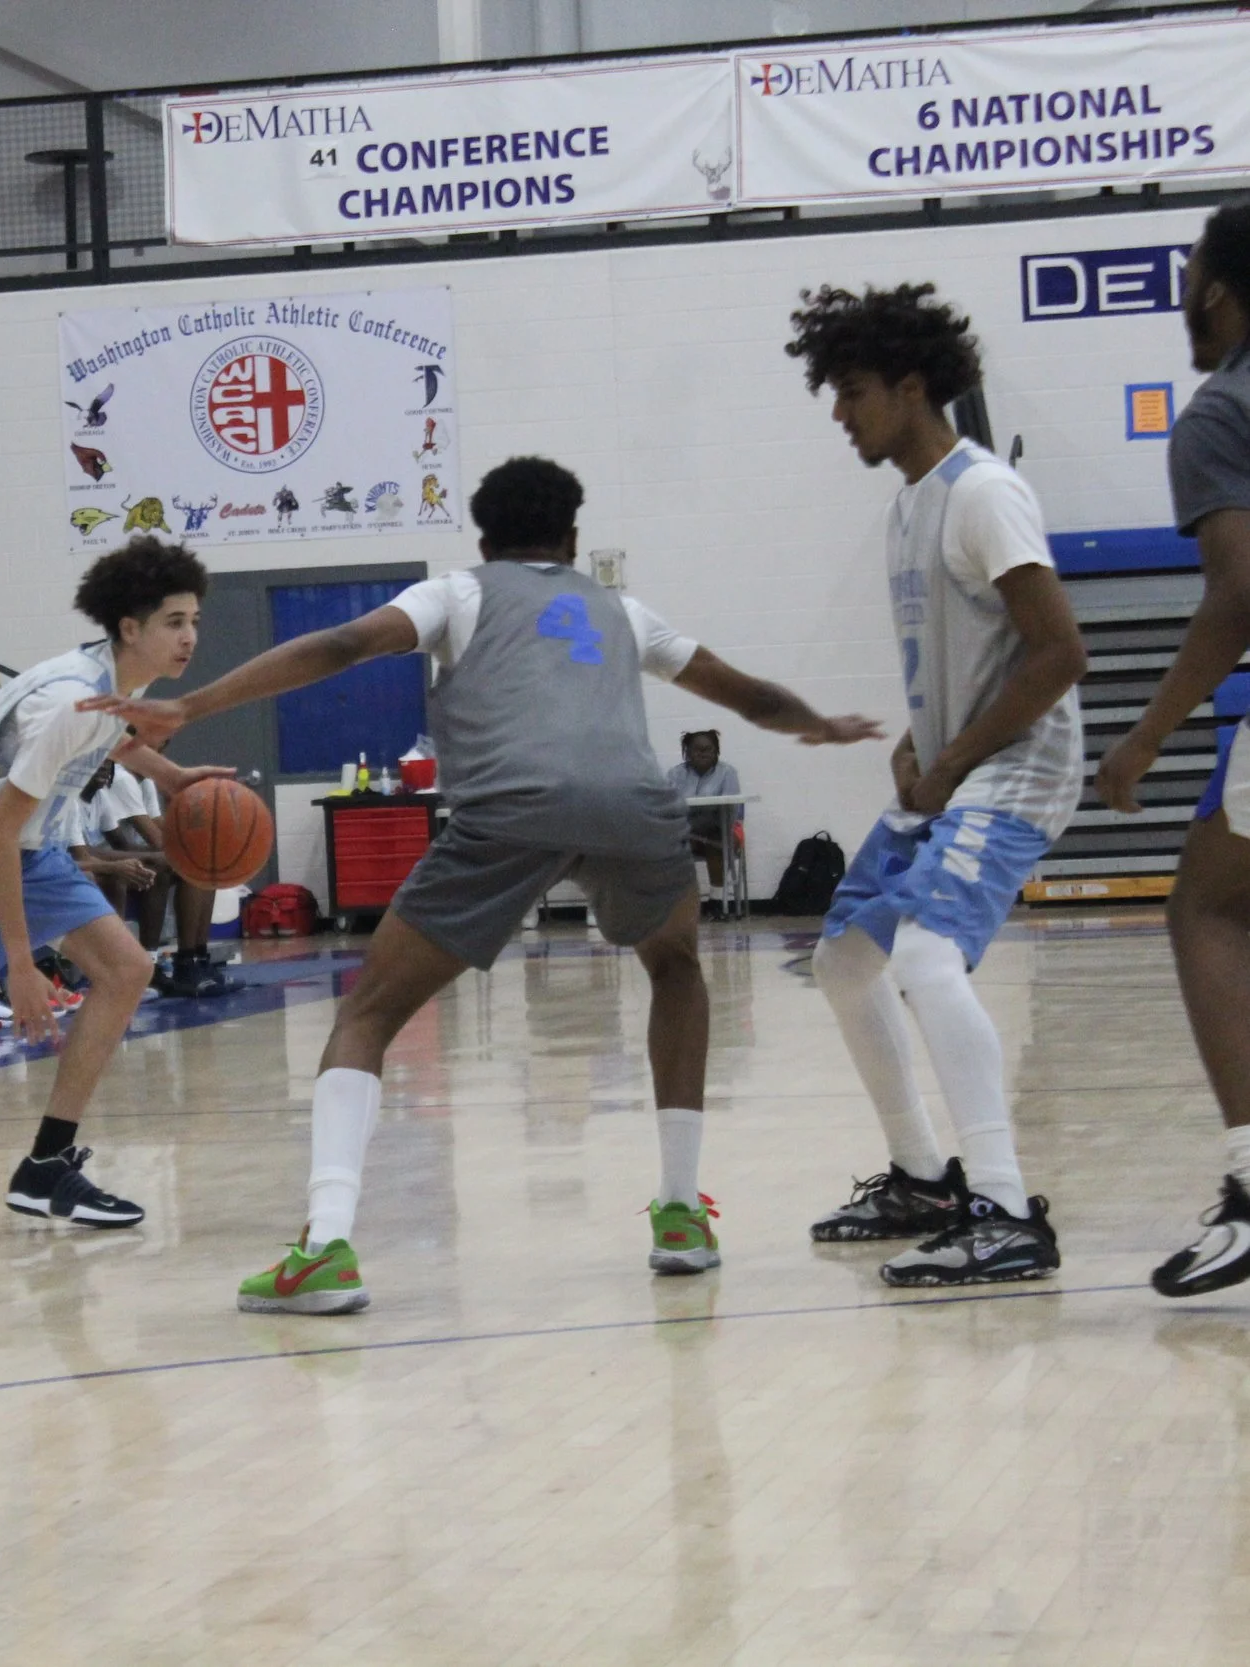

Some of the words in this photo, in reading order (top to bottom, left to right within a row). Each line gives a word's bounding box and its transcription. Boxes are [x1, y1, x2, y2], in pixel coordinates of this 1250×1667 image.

[917, 101, 940, 130] 6
[952, 84, 1162, 129] NATIONAL
[309, 148, 338, 167] 41
[356, 126, 609, 174] CONFERENCE
[868, 125, 1215, 177] CHAMPIONSHIPS
[338, 173, 575, 219] CHAMPIONS
[66, 325, 172, 383] Washington
[178, 306, 255, 336] Catholic
[265, 302, 340, 328] Athletic
[349, 309, 447, 361] Conference
[201, 340, 253, 384] CATHOLIC
[257, 341, 310, 377] ATHLETIC
[193, 386, 232, 462] WASHINGTON
[286, 378, 319, 457] CONFERENCE
[364, 481, 400, 513] KNIGHTS
[537, 592, 603, 664] 4
